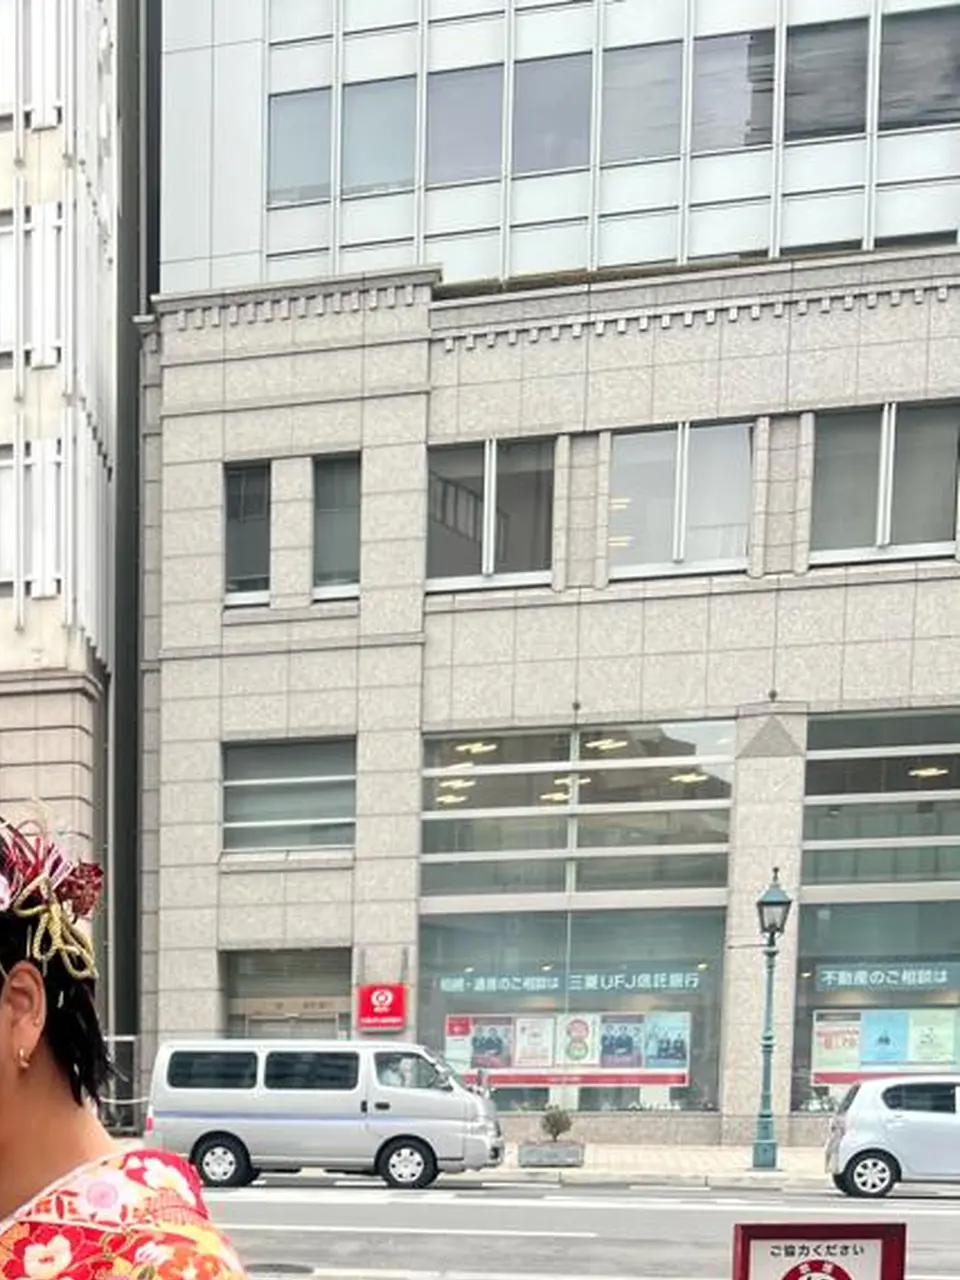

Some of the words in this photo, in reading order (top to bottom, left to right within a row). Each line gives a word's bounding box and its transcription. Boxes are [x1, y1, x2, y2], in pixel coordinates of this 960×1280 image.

[770, 1243, 864, 1258] ご協力ください
